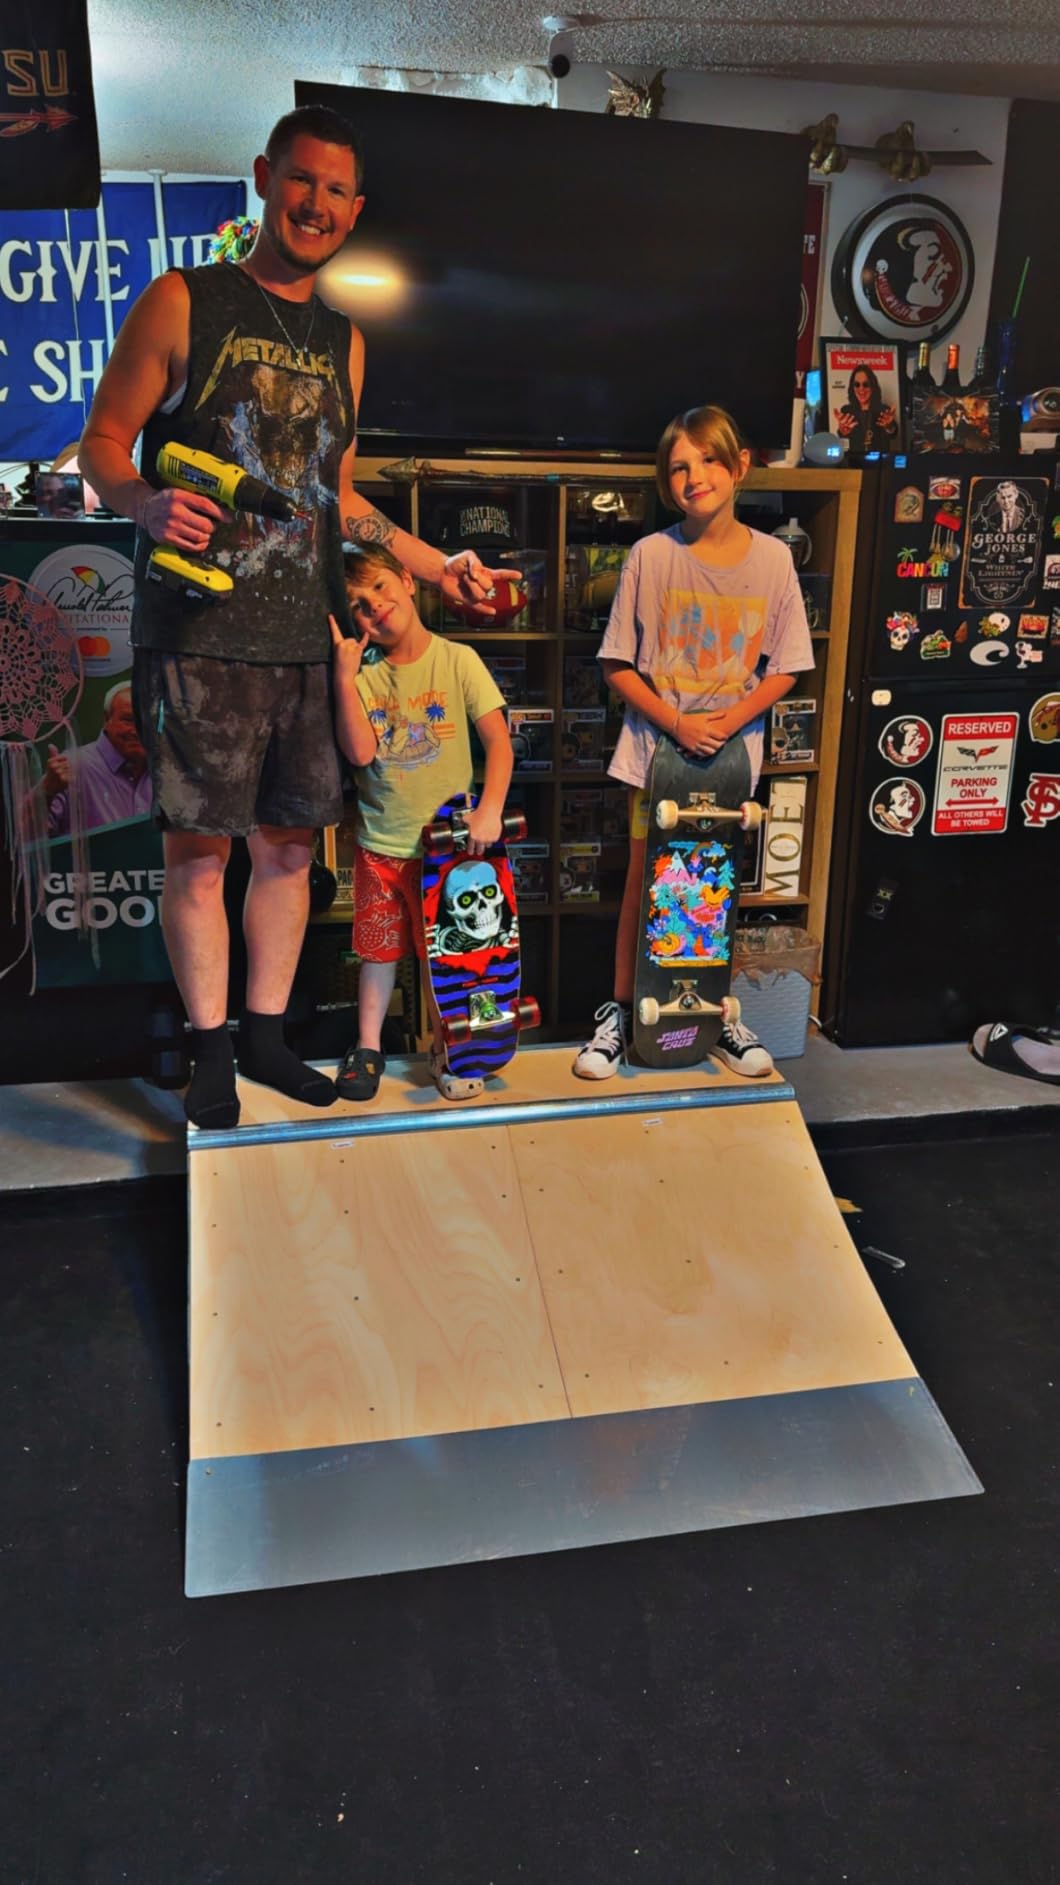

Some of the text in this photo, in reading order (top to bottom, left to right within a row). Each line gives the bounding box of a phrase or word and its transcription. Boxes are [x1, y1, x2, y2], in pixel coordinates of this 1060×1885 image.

[0, 239, 130, 303] GIVE
[836, 354, 888, 366] Newsweek
[30, 338, 112, 404] SH
[971, 533, 1037, 549] GEORGE
[984, 544, 1025, 556] JONES
[948, 721, 1012, 735] RESERVED
[943, 764, 1009, 772] CORVETTE
[950, 777, 998, 788] PARKING
[959, 788, 988, 798] ONLY
[938, 809, 1004, 820] ALL OTHERS WILL
[950, 818, 991, 828] BE TOWED
[44, 869, 165, 894] GREATE
[46, 895, 164, 930] GOO
